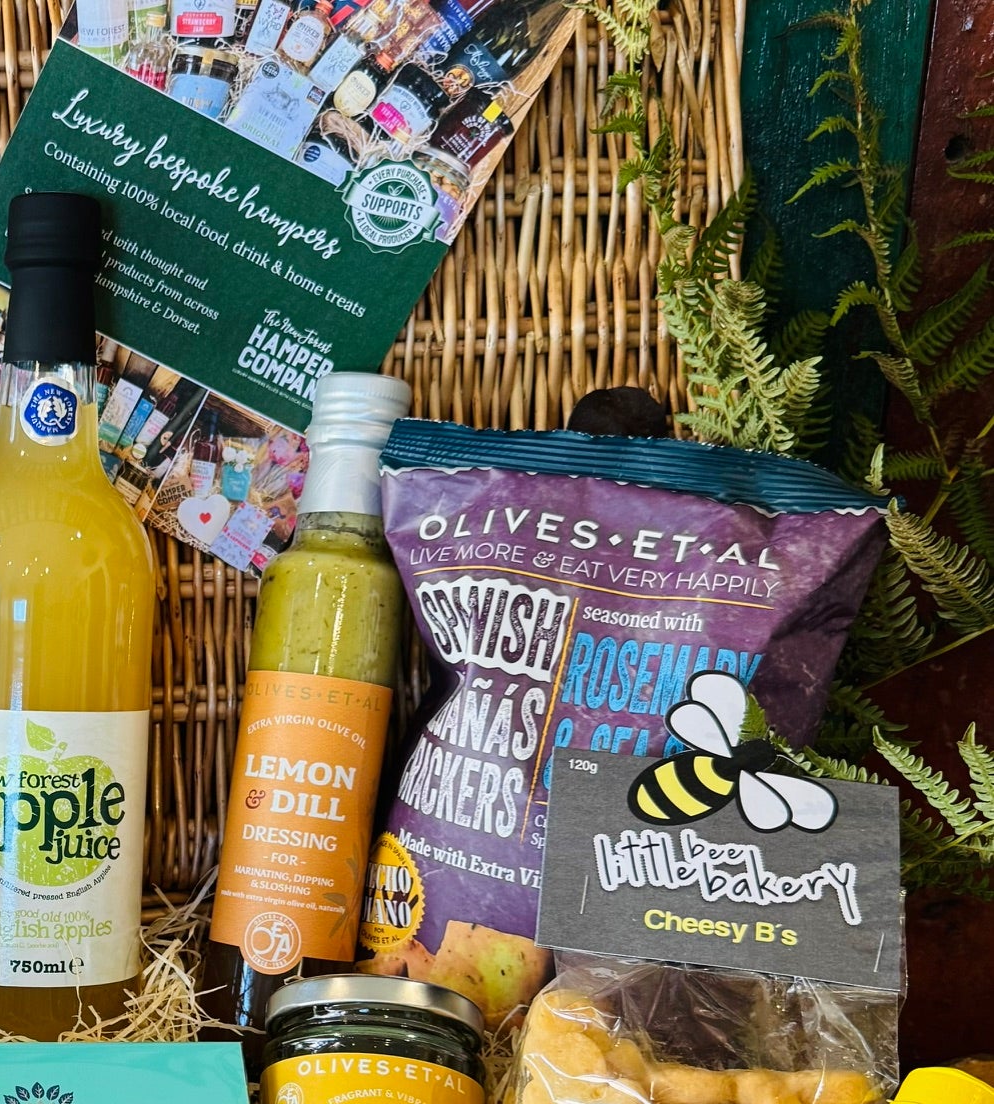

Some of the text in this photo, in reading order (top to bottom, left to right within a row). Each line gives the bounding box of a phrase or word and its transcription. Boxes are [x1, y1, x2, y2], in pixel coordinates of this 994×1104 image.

[52, 88, 341, 259] Luxury bespoke hampers
[361, 193, 423, 220] SUPPORTS
[44, 142, 366, 318] Containing 100% local food, drink & home treats
[114, 234, 139, 254] with
[140, 246, 184, 278] thought
[184, 272, 208, 291] and
[247, 324, 334, 377] HAMPER
[237, 347, 318, 402] COMPAN
[410, 542, 780, 598] LIVE MORE & EAT VERY HAPPILY
[583, 606, 703, 632] seasoned with
[247, 715, 367, 750] EXTRA VIRGIN OLIVE OIL
[19, 771, 80, 789] forest
[244, 754, 356, 789] LEMON
[568, 758, 598, 774] 120g
[245, 789, 346, 822] & DILL
[46, 827, 121, 864] juice
[242, 824, 338, 851] DRESSING
[234, 865, 334, 887] MARINATING, DIPPING
[597, 831, 745, 888] little bee
[702, 847, 858, 922] bakery
[53, 919, 112, 944] apples
[644, 910, 748, 944] Cheesy
[385, 1089, 394, 1098] &
